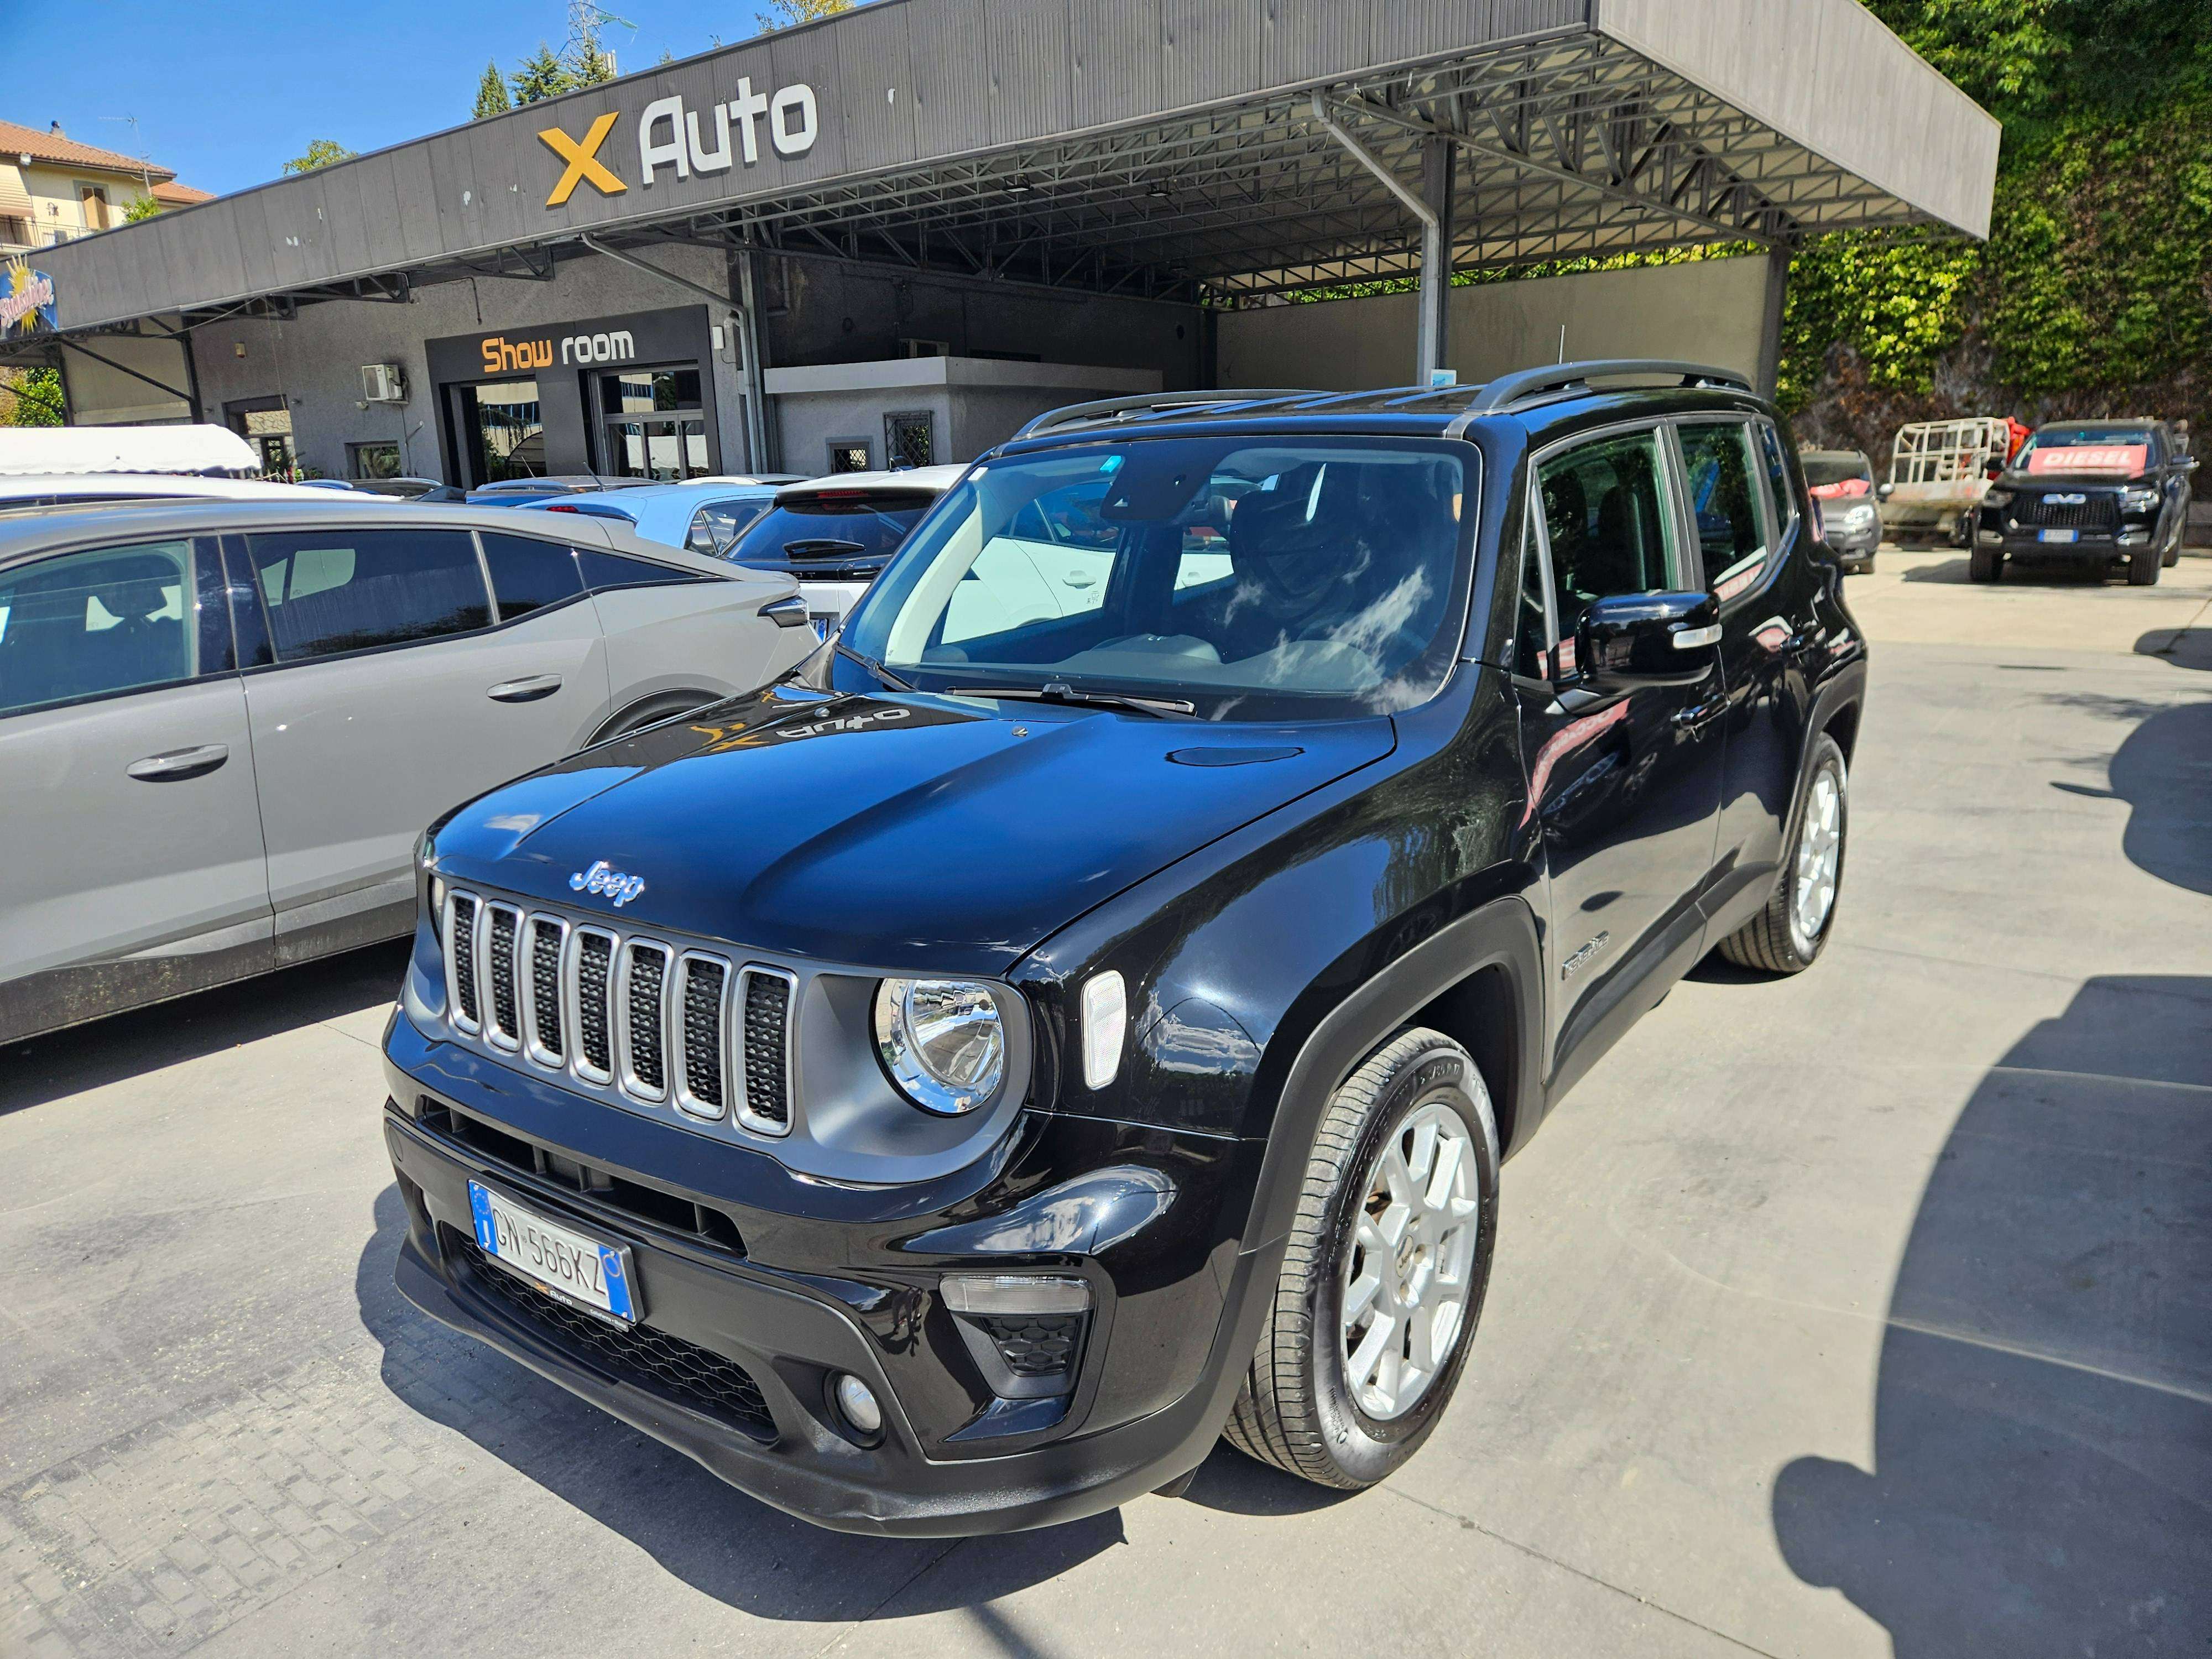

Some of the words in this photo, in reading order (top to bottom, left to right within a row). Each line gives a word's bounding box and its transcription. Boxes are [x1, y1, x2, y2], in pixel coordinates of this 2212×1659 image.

[538, 111, 628, 206] X
[639, 76, 818, 185] Auto
[481, 337, 553, 373] Show
[561, 330, 635, 365] room
[2043, 450, 2132, 466] DIESEL
[569, 860, 644, 907] Jeep
[492, 1206, 523, 1258] GN
[527, 1224, 609, 1297] 566KZ
[549, 1290, 572, 1306] Auto
